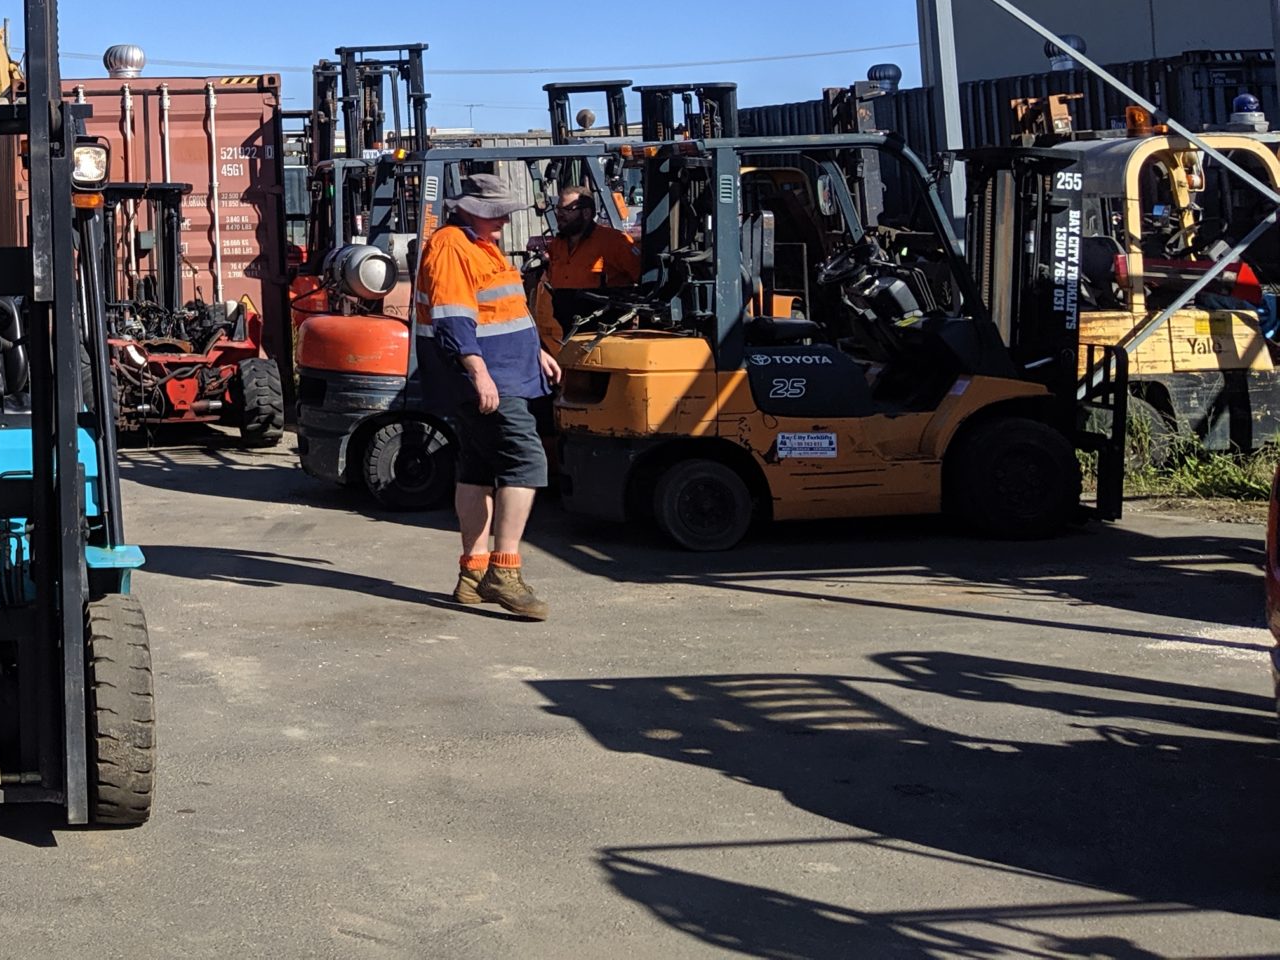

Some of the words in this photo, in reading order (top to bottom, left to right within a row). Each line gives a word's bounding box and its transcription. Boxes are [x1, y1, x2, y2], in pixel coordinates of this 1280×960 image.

[221, 164, 243, 176] 45G1
[1056, 172, 1082, 190] 255
[1069, 210, 1081, 234] BAY
[1055, 226, 1067, 257] 1300
[1068, 236, 1080, 264] CITY
[1054, 261, 1066, 285] 763
[1053, 289, 1065, 311] 031
[1066, 266, 1079, 330] FORKLIFTS
[1187, 337, 1222, 355] Yale
[772, 355, 832, 364] TOYOTA
[769, 378, 806, 398] 25
